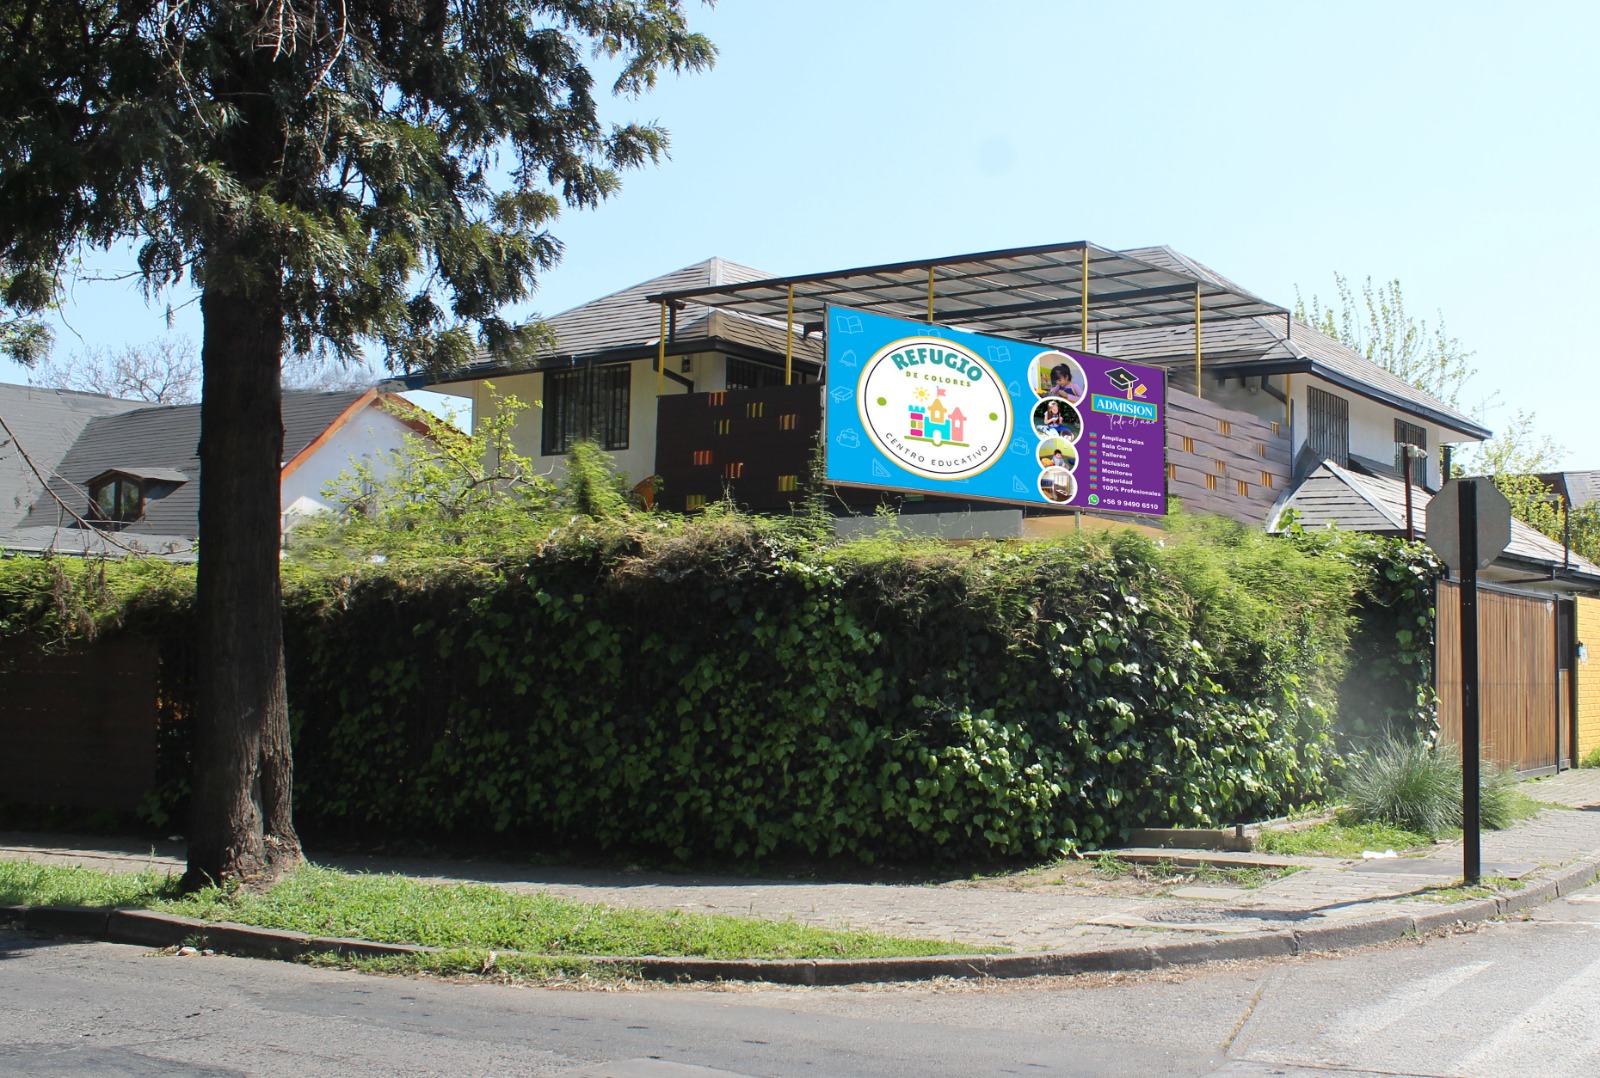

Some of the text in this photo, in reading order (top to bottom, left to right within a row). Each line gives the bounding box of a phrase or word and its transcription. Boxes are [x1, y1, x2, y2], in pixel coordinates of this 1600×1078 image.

[891, 348, 983, 381] REFUGIO
[905, 371, 972, 387] DE COLORES
[1097, 399, 1153, 416] ADMISION
[1102, 434, 1126, 443] Amplias
[885, 432, 989, 467] CENTRO EDUCATIVO
[1102, 451, 1127, 459] Talleres
[1102, 468, 1133, 477] Monitoreo
[1102, 477, 1132, 485] Seguridad
[1120, 487, 1161, 497] Profesionales
